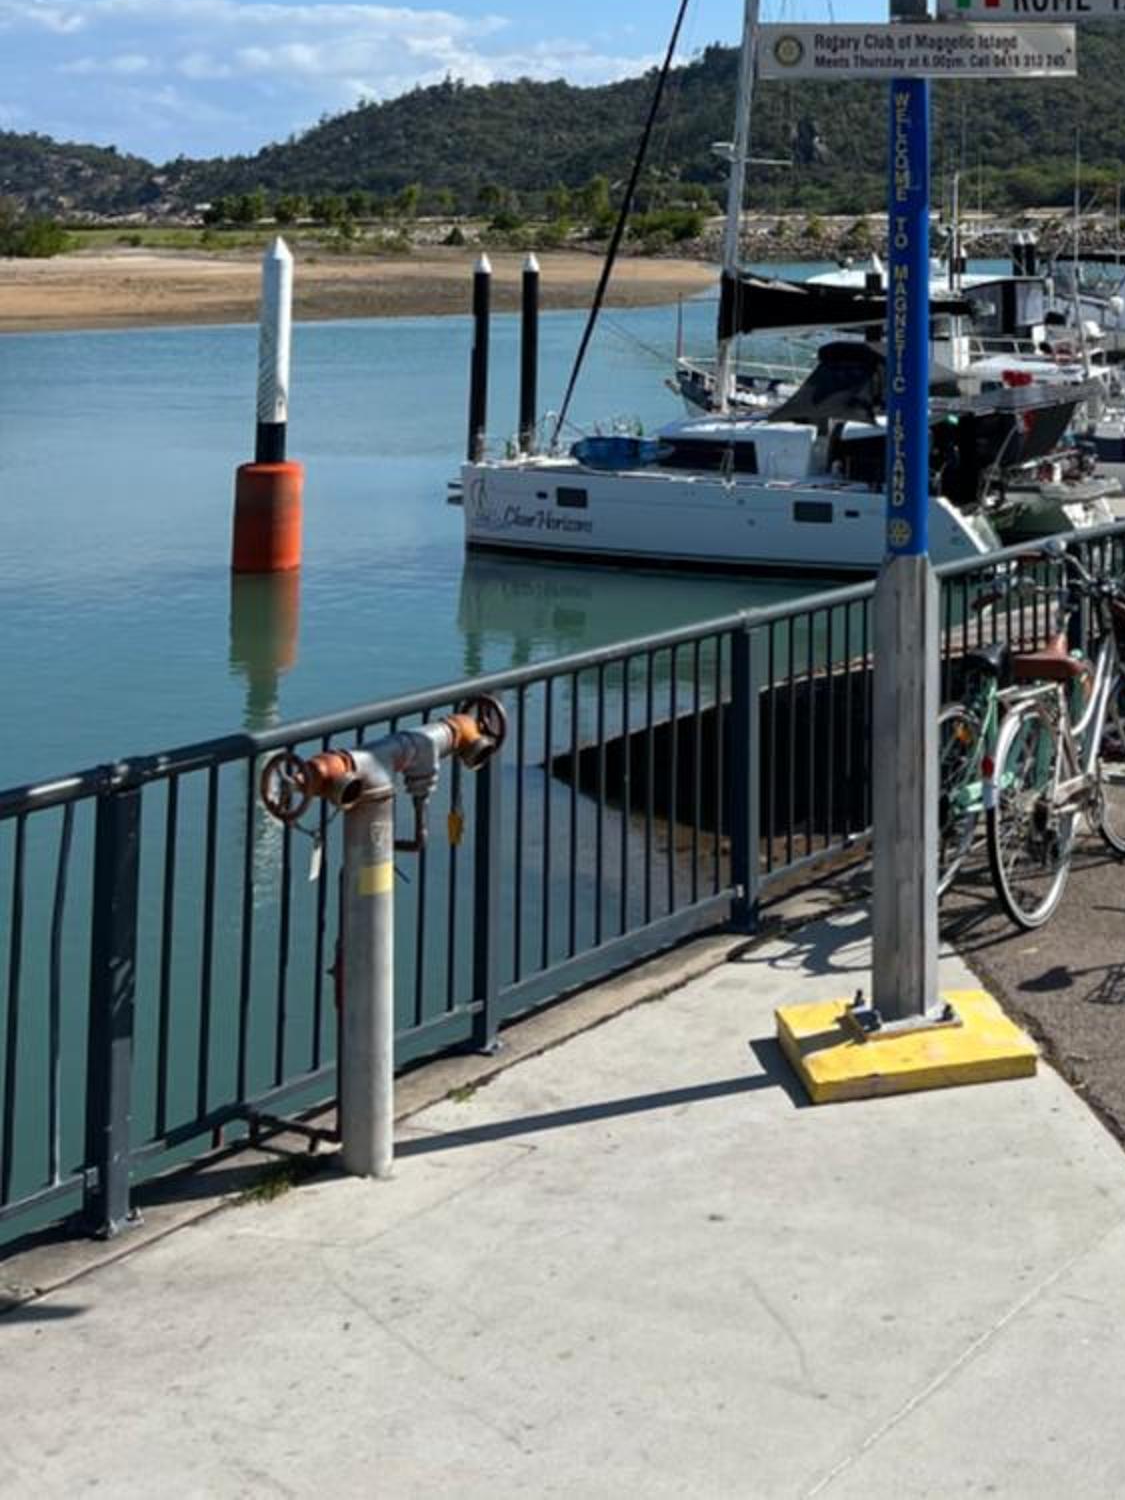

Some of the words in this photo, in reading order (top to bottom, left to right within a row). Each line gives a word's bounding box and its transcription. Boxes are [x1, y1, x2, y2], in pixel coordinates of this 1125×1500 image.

[815, 34, 860, 52] Rotary
[864, 34, 895, 50] Club
[898, 34, 912, 50] of
[915, 34, 976, 53] Magnetic
[978, 35, 1017, 50] Island
[815, 55, 849, 68] Meets
[854, 54, 905, 69] Thursday
[895, 92, 911, 202] WELCOME
[894, 219, 908, 249] TO
[892, 264, 908, 393] MAGNETIC
[891, 408, 906, 507] ISLAND
